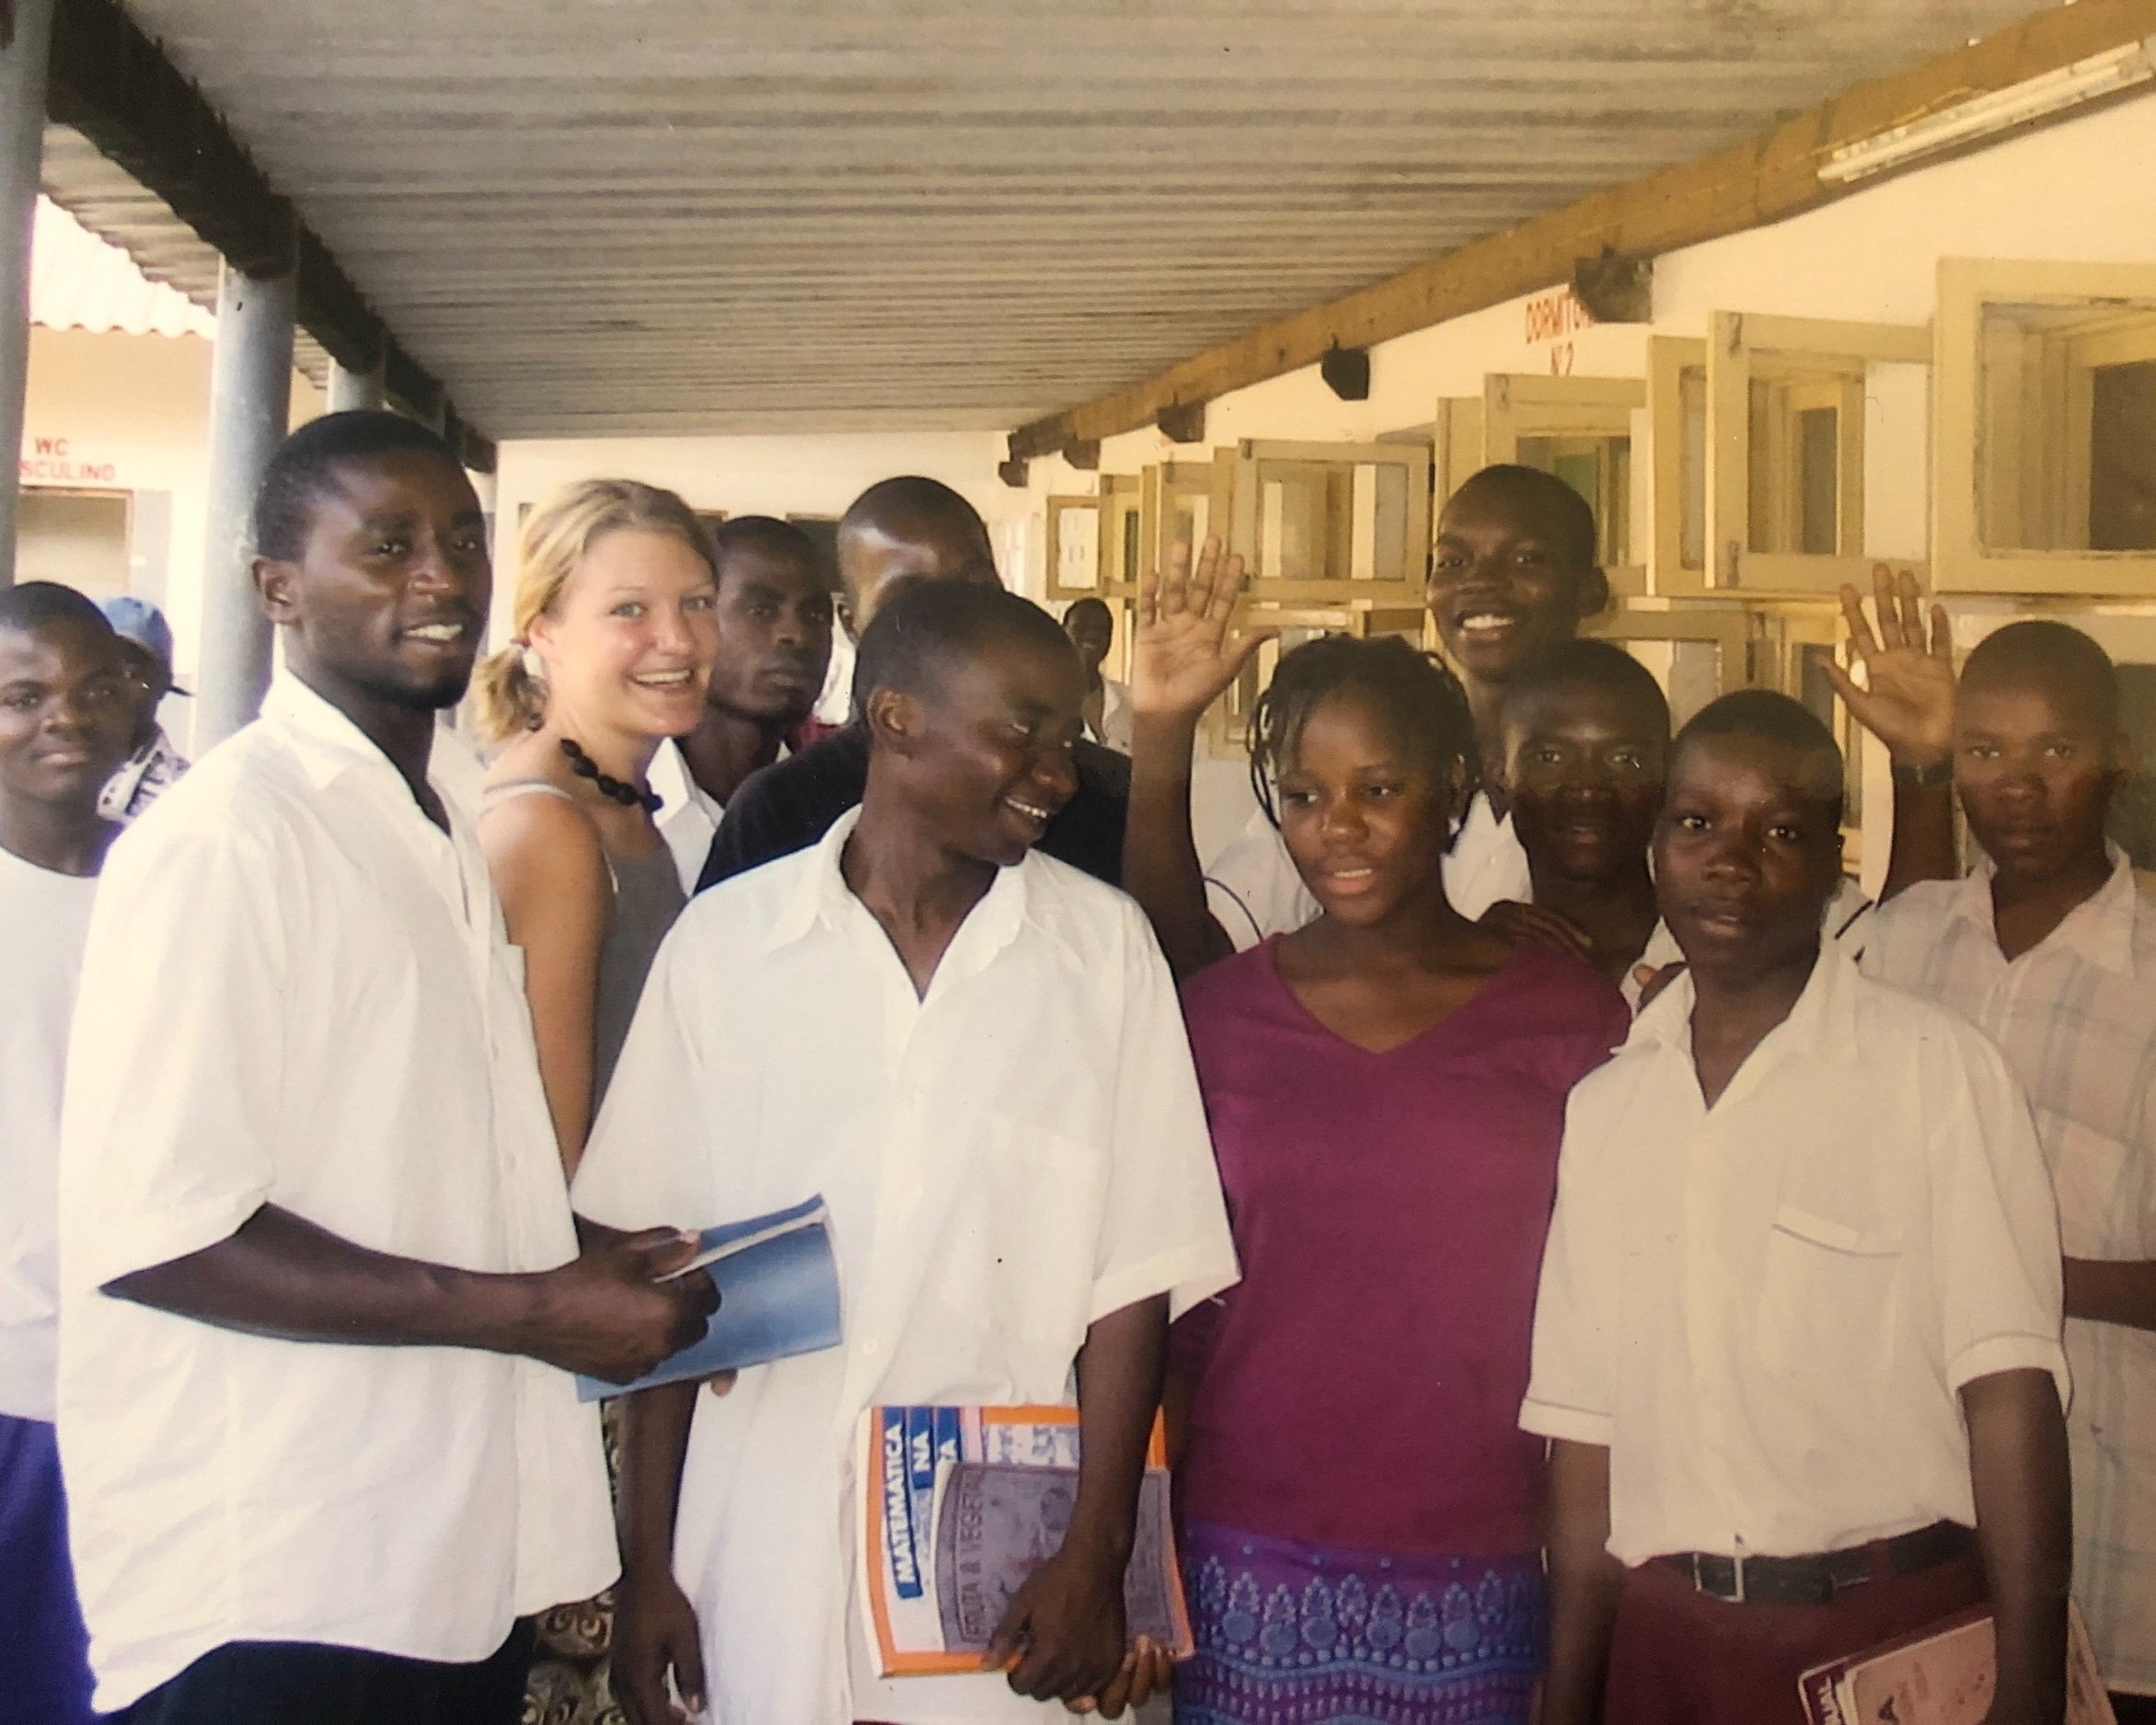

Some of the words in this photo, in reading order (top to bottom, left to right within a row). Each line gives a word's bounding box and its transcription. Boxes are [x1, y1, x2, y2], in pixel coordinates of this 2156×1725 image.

[35, 437, 69, 456] WC
[17, 460, 116, 481] SCULINO
[912, 1431, 931, 1472] NA
[885, 1424, 917, 1583] MATEMATICA
